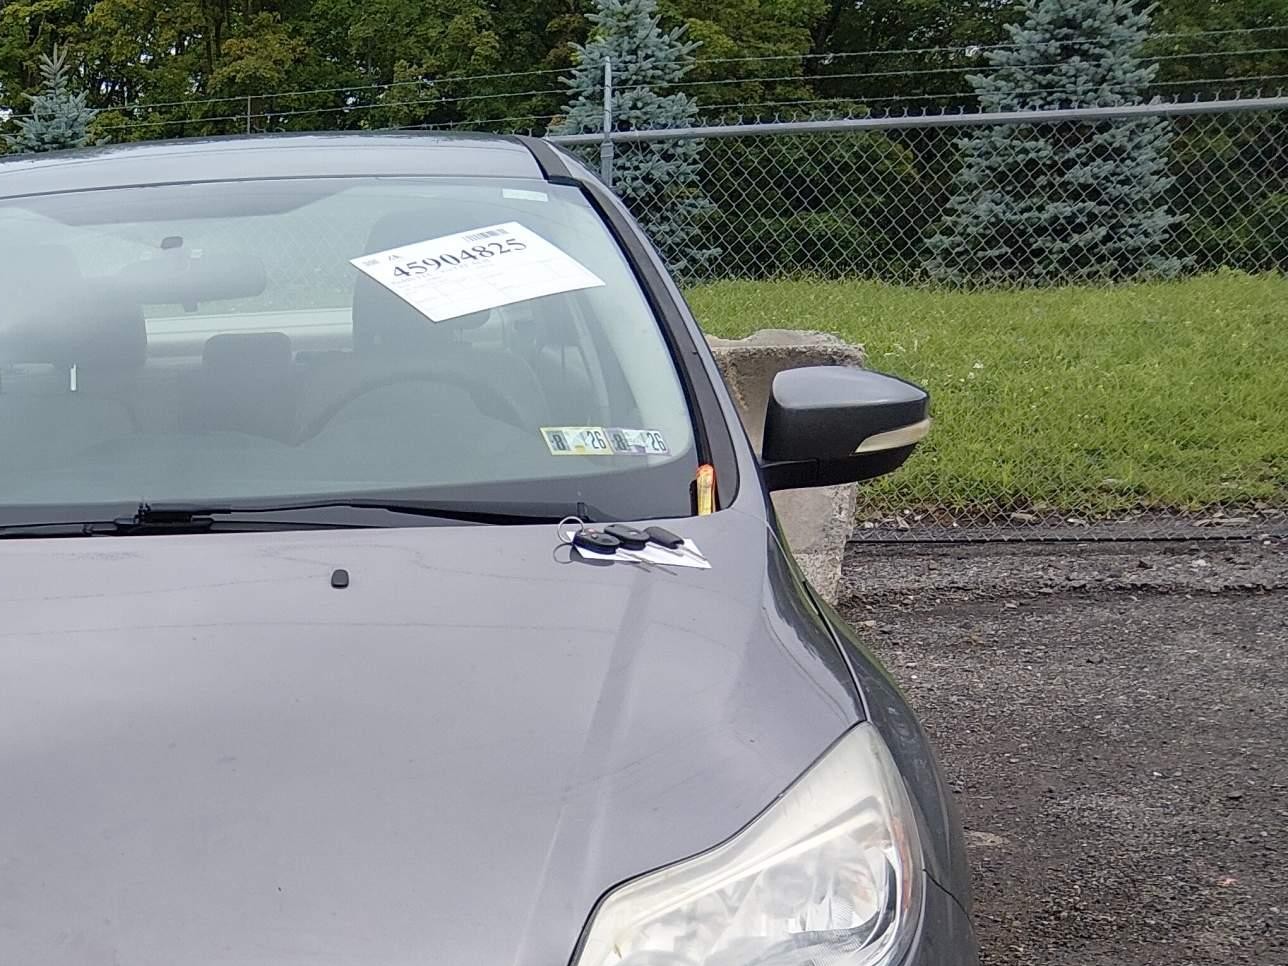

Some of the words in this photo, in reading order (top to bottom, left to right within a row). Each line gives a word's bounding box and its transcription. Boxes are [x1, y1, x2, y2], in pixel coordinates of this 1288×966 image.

[392, 238, 528, 278] 45904825
[586, 431, 607, 450] 26
[646, 431, 667, 451] 26
